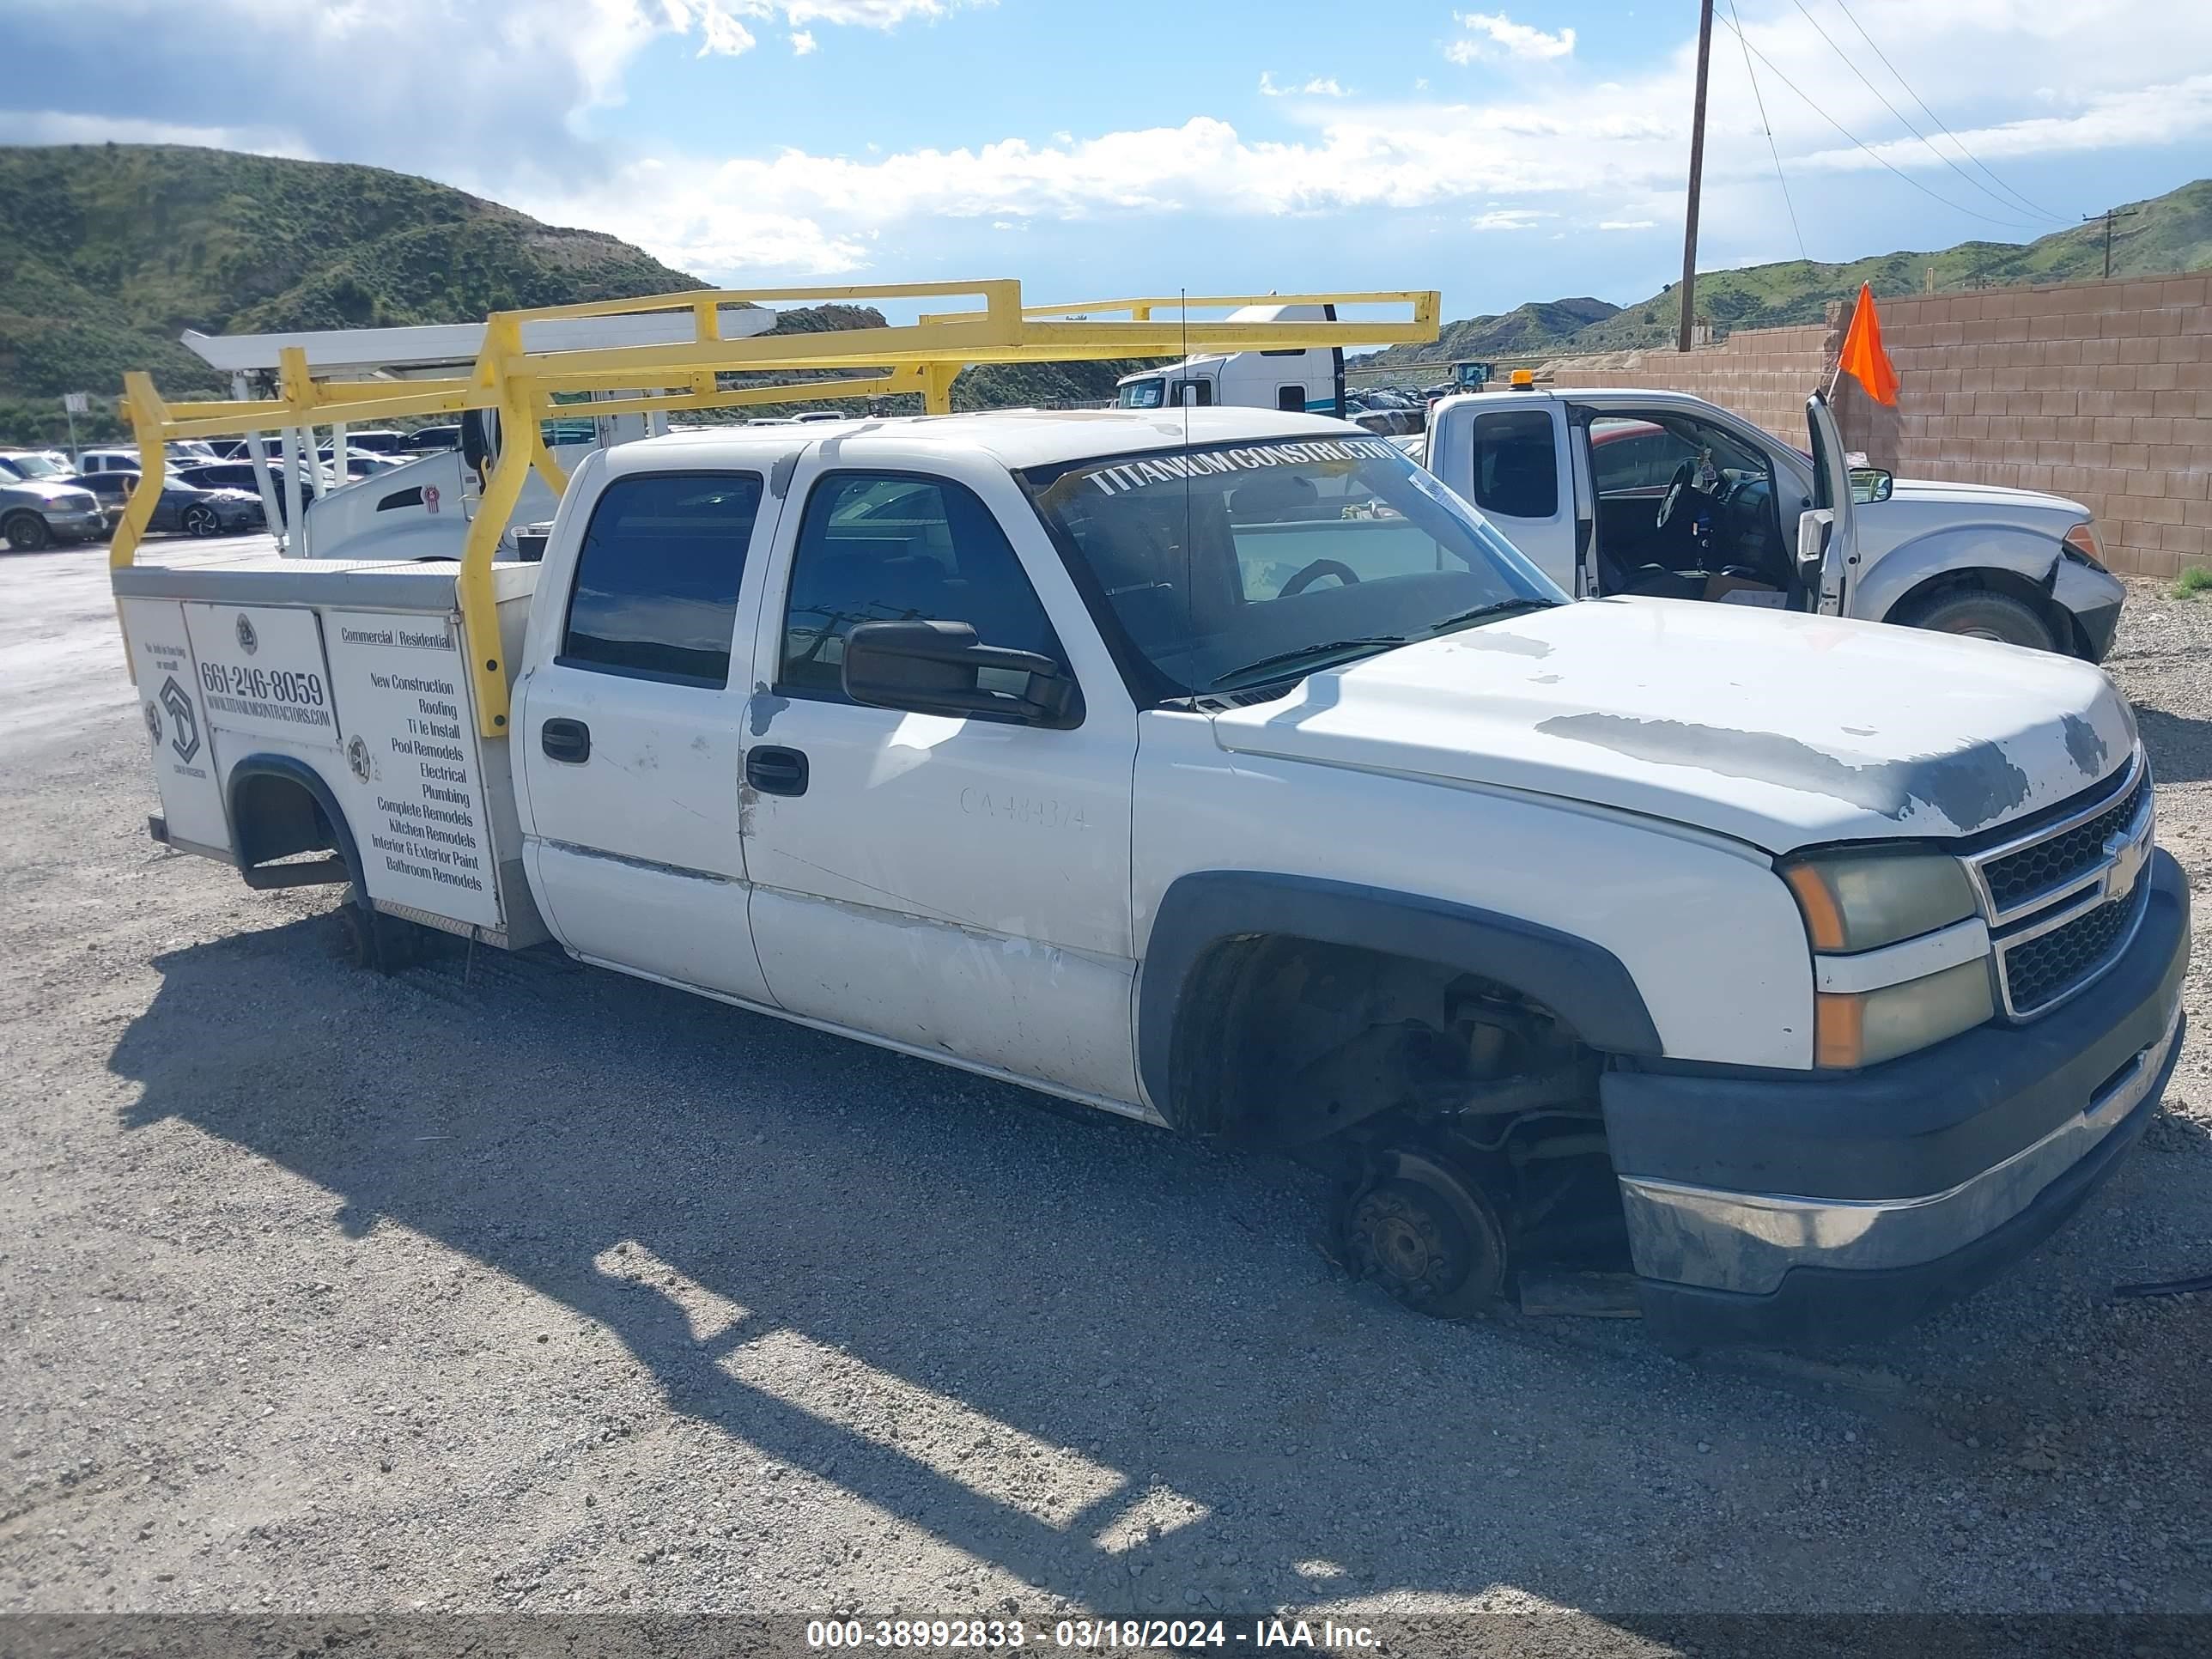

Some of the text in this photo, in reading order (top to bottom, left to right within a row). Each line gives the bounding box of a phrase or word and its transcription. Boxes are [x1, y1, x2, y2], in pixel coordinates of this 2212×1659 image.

[1082, 452, 1235, 496] TITANIUM
[342, 627, 392, 645] Commercial
[399, 631, 450, 648] Residential
[201, 662, 324, 706] 661-246-8059
[370, 672, 453, 695] New Construction
[418, 699, 458, 720] Roofing
[430, 721, 460, 739] Install
[392, 738, 464, 762] Pool Remodels
[420, 763, 467, 783] Electrical
[422, 784, 470, 808] Plumbing
[378, 796, 473, 827] Complete Remodels
[389, 818, 476, 848] Kitchen Remodels
[372, 835, 479, 870] Interior & Exterior Paint
[386, 857, 482, 891] Bathroom Remodels
